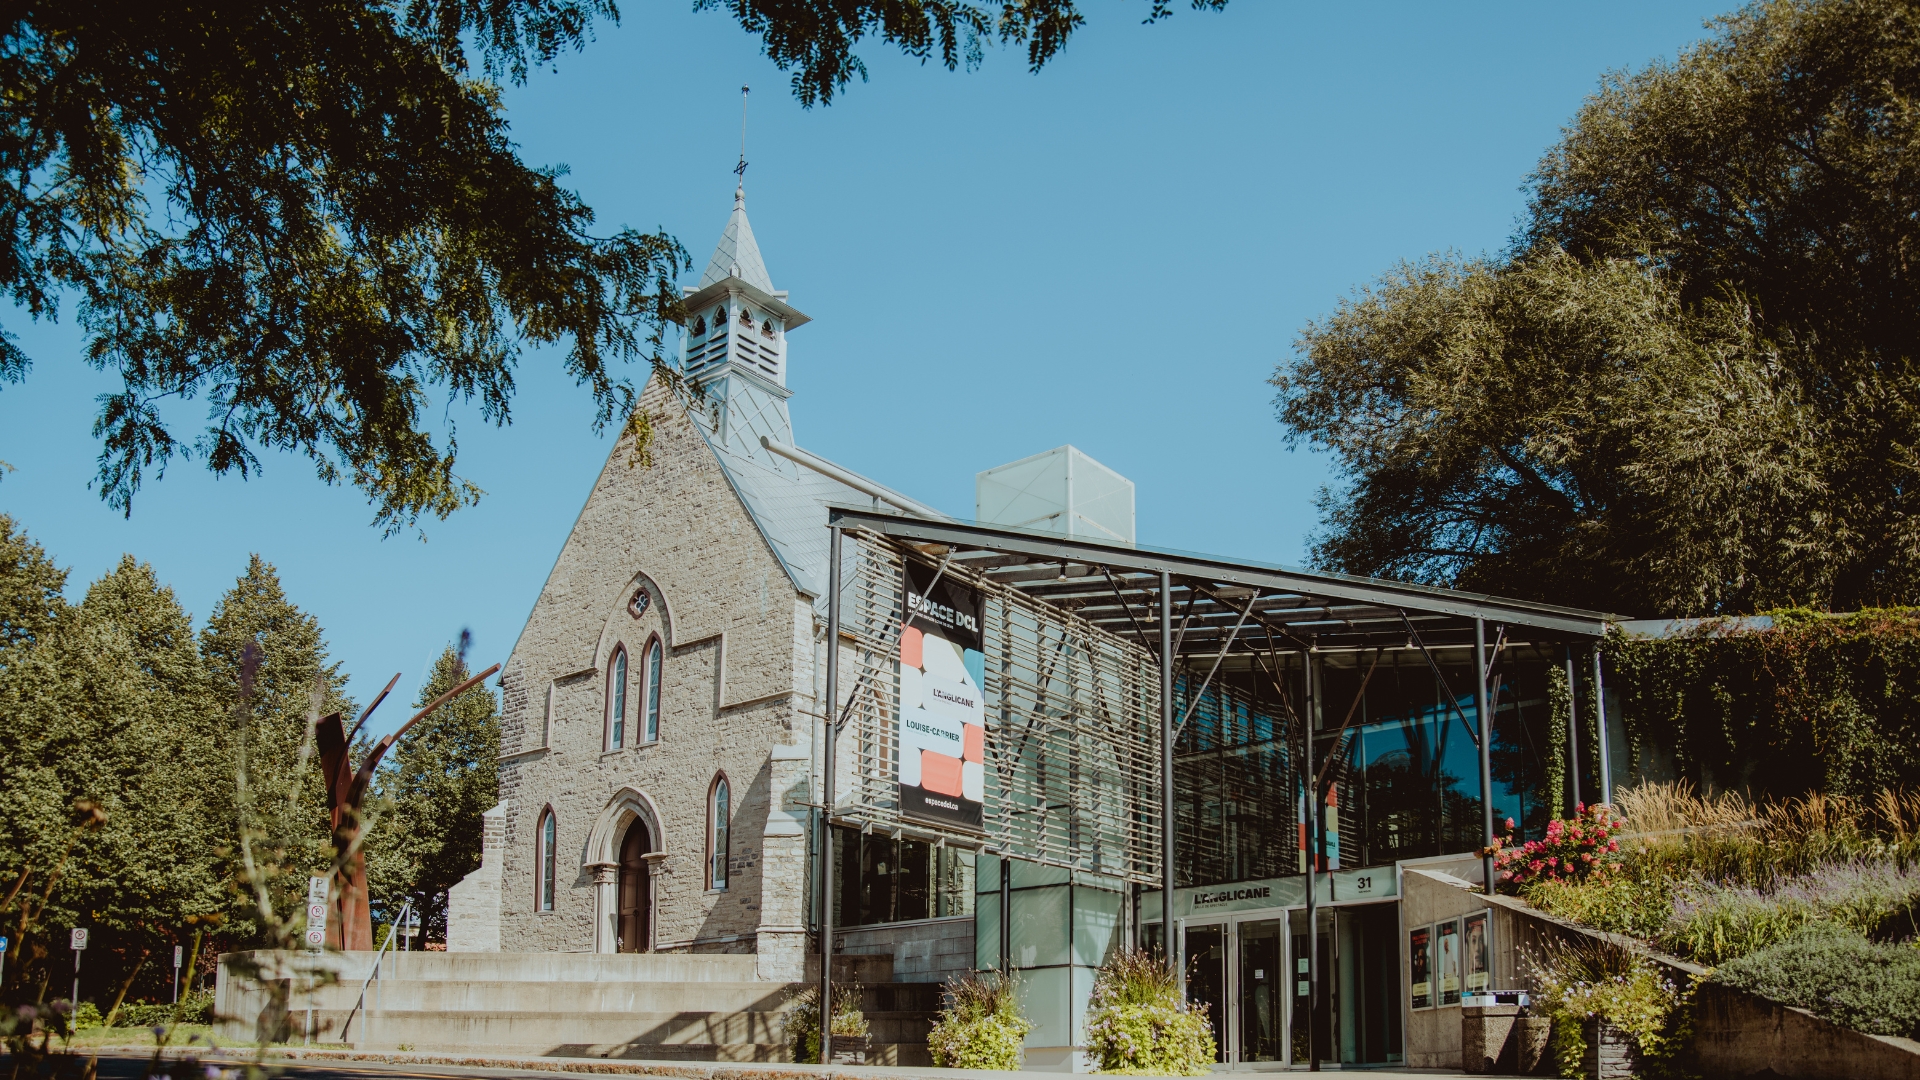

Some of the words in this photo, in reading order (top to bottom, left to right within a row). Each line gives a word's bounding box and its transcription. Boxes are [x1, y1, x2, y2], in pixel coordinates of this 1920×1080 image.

[907, 591, 954, 624] ESPACE
[955, 610, 979, 633] DCL
[933, 688, 974, 709] L'ANGLICANE
[315, 878, 324, 888] P
[1357, 876, 1371, 889] 31
[1194, 886, 1270, 905] L'ANGLICANE
